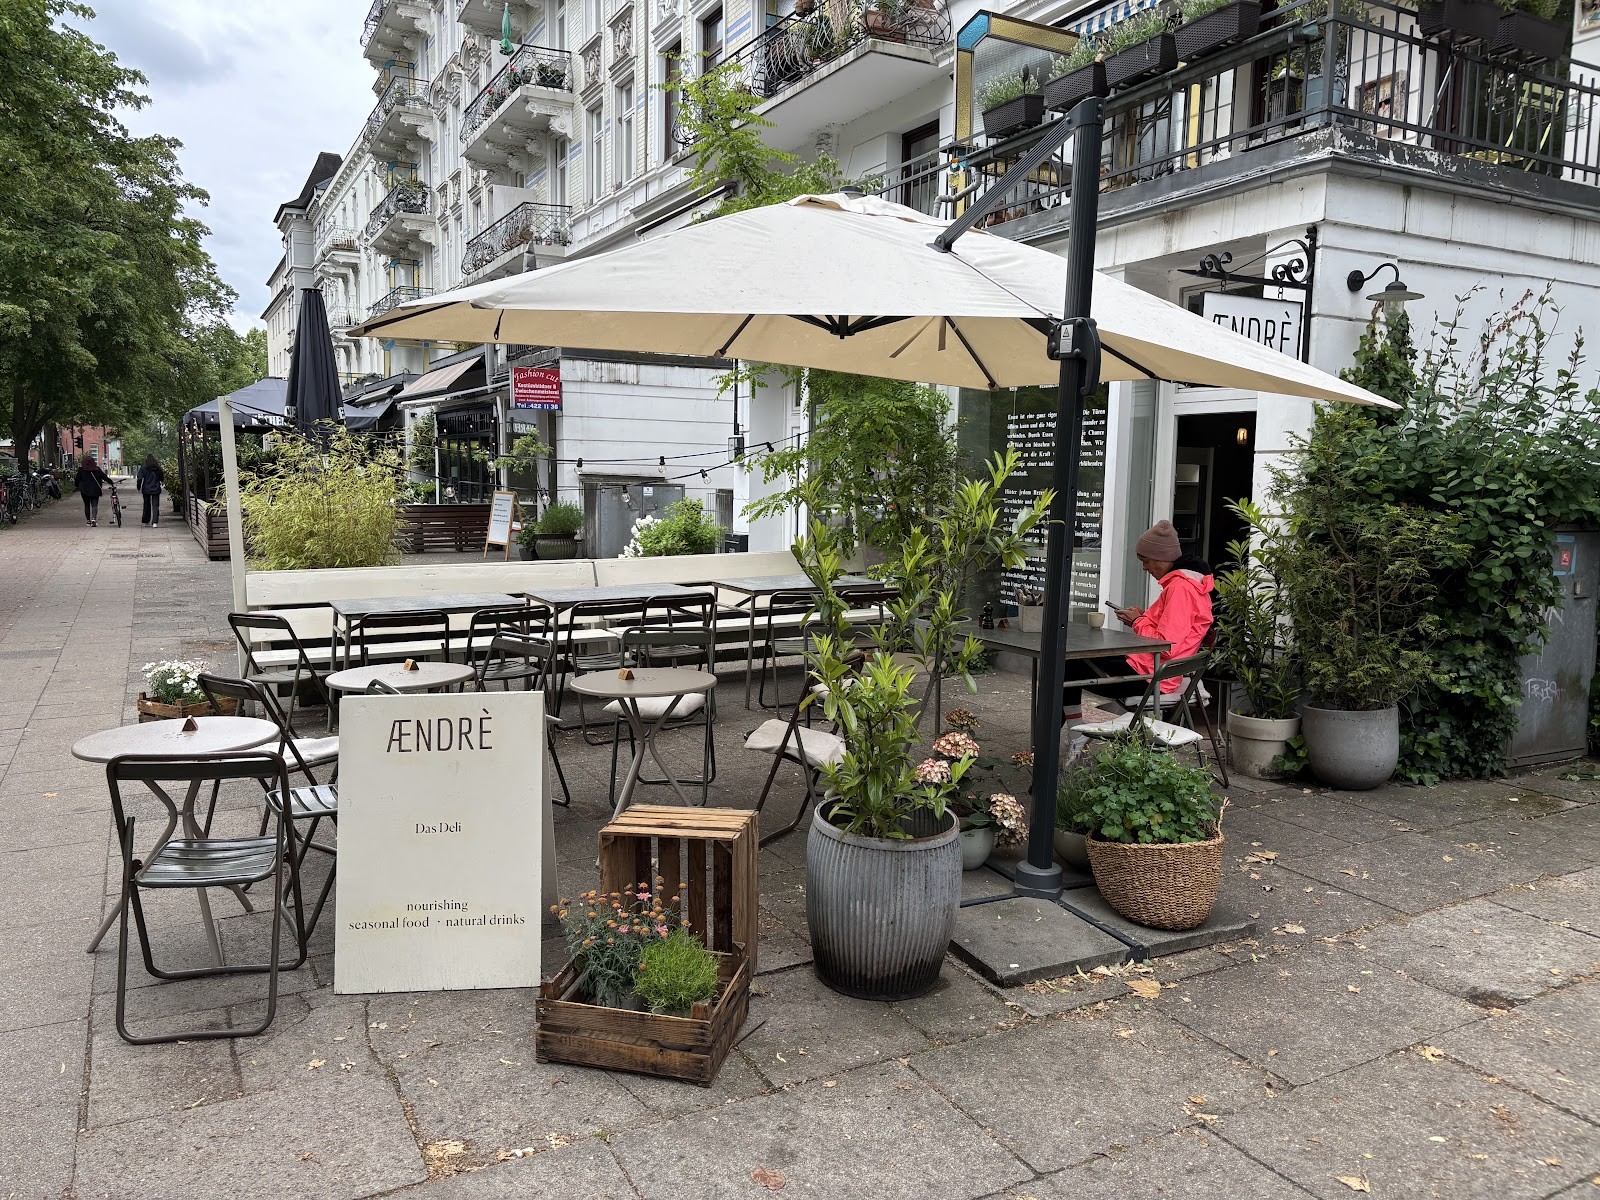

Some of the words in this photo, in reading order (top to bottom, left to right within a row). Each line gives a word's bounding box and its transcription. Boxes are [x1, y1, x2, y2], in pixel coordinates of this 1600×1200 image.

[514, 368, 545, 383] Fashion
[546, 373, 560, 383] cut
[386, 707, 494, 753] ÆNDRÈ
[415, 823, 437, 834] Das
[439, 821, 462, 834] Deli
[406, 899, 469, 913] nourishing
[348, 917, 399, 931] seasonal
[401, 916, 429, 930] food
[445, 914, 486, 928] natural
[489, 913, 525, 926] drinks
